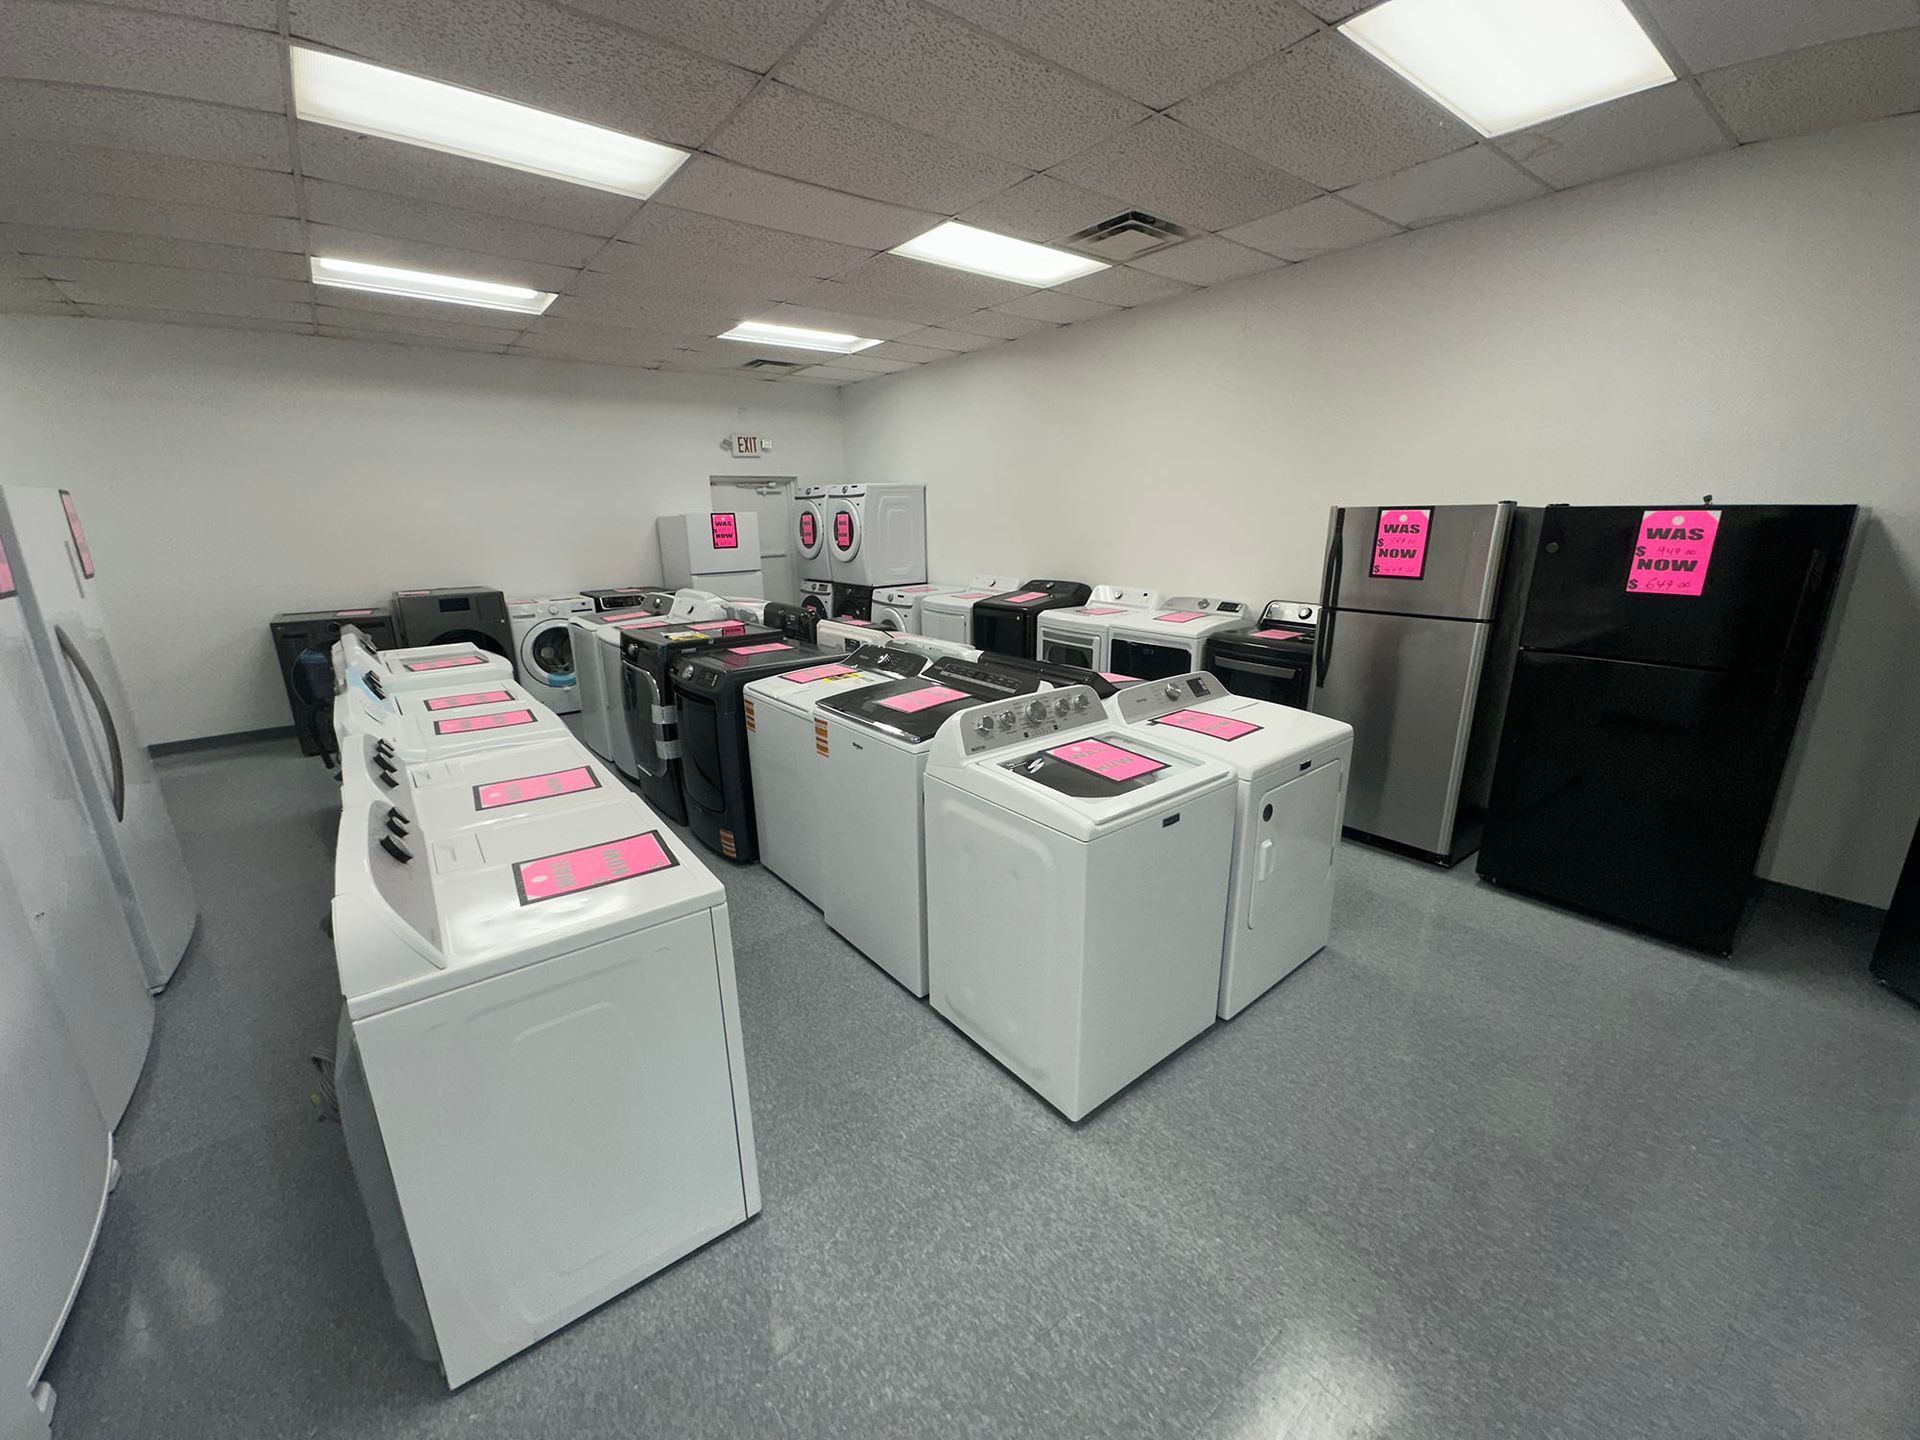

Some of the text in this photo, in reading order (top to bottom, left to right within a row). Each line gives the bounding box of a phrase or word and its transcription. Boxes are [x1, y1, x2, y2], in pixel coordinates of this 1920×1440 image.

[737, 436, 757, 453] EXIT
[1384, 524, 1420, 534] WAS
[1646, 528, 1704, 541] WAS
[1377, 538, 1385, 547] $
[1379, 548, 1417, 558] NOW
[1635, 545, 1646, 557] $
[1373, 564, 1381, 573] $
[1636, 558, 1698, 572] NOW
[1628, 579, 1638, 590] $
[602, 848, 631, 877] NOW
